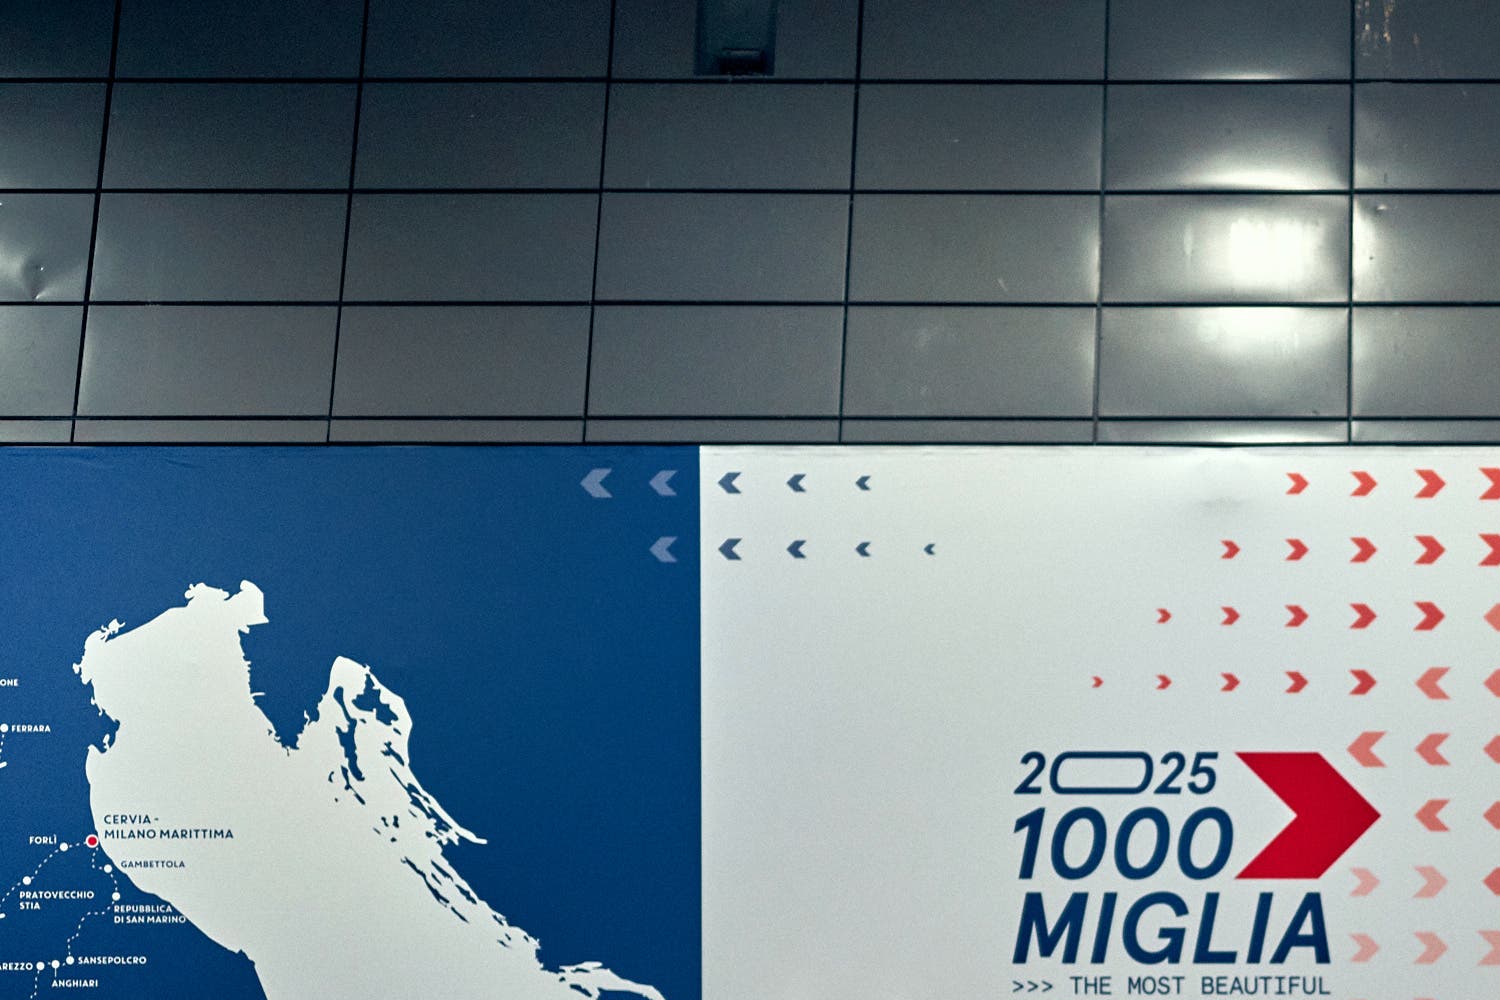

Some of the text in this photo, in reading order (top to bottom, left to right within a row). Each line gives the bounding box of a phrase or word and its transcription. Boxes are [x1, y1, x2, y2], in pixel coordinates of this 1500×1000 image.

[12, 725, 51, 733] FERRARA
[1014, 751, 1218, 794] 2025
[104, 815, 152, 825] CERVIA
[105, 829, 234, 840] MILANO MARITTIMA
[30, 834, 57, 845] FORLÌ
[1014, 807, 1234, 880] 1000
[121, 861, 185, 869] GAMBETTOLA
[20, 891, 95, 900] PRATOVECCHIO
[20, 902, 41, 910] STIA
[114, 905, 173, 913] REPUBBLICA
[114, 916, 187, 924] DI SAN MARINO
[1013, 892, 1331, 965] MIGLIA
[78, 956, 147, 965] SANSEPOLCRO
[0, 963, 34, 971] REZZO
[52, 980, 99, 988] ANGHIARI
[1070, 976, 1111, 995] THE
[1128, 976, 1185, 995] MOST
[1202, 976, 1330, 995] BEAUTIFUL
